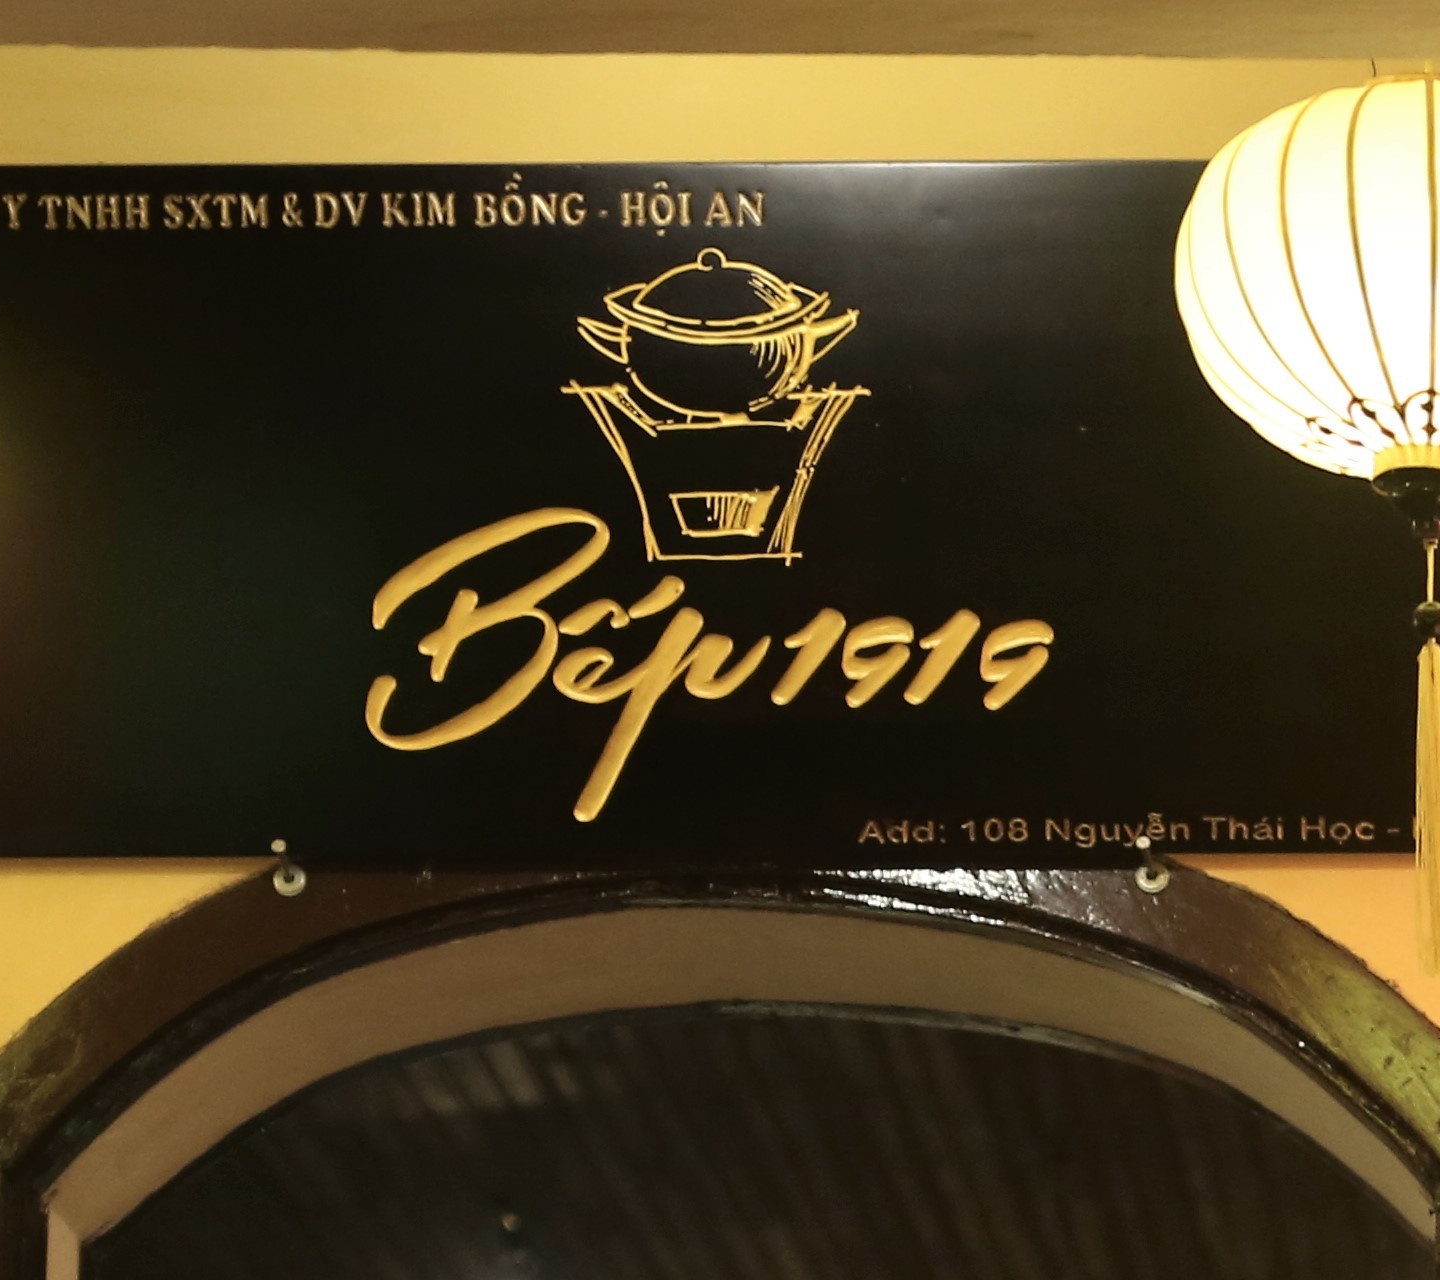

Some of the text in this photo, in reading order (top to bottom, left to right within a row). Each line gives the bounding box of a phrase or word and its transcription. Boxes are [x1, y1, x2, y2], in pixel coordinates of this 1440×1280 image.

[37, 193, 150, 231] TNHH
[162, 192, 268, 230] SXTM
[281, 192, 304, 229] &
[314, 192, 367, 229] DV
[381, 192, 457, 229] KIM
[473, 171, 587, 228] BỒNG
[620, 180, 692, 237] HỘI
[703, 191, 765, 228] AN
[857, 819, 947, 845] Add:
[960, 817, 1030, 843] 108
[1043, 812, 1191, 849] Nguyễn
[1202, 816, 1285, 842] Thái
[1299, 815, 1376, 847] Học
